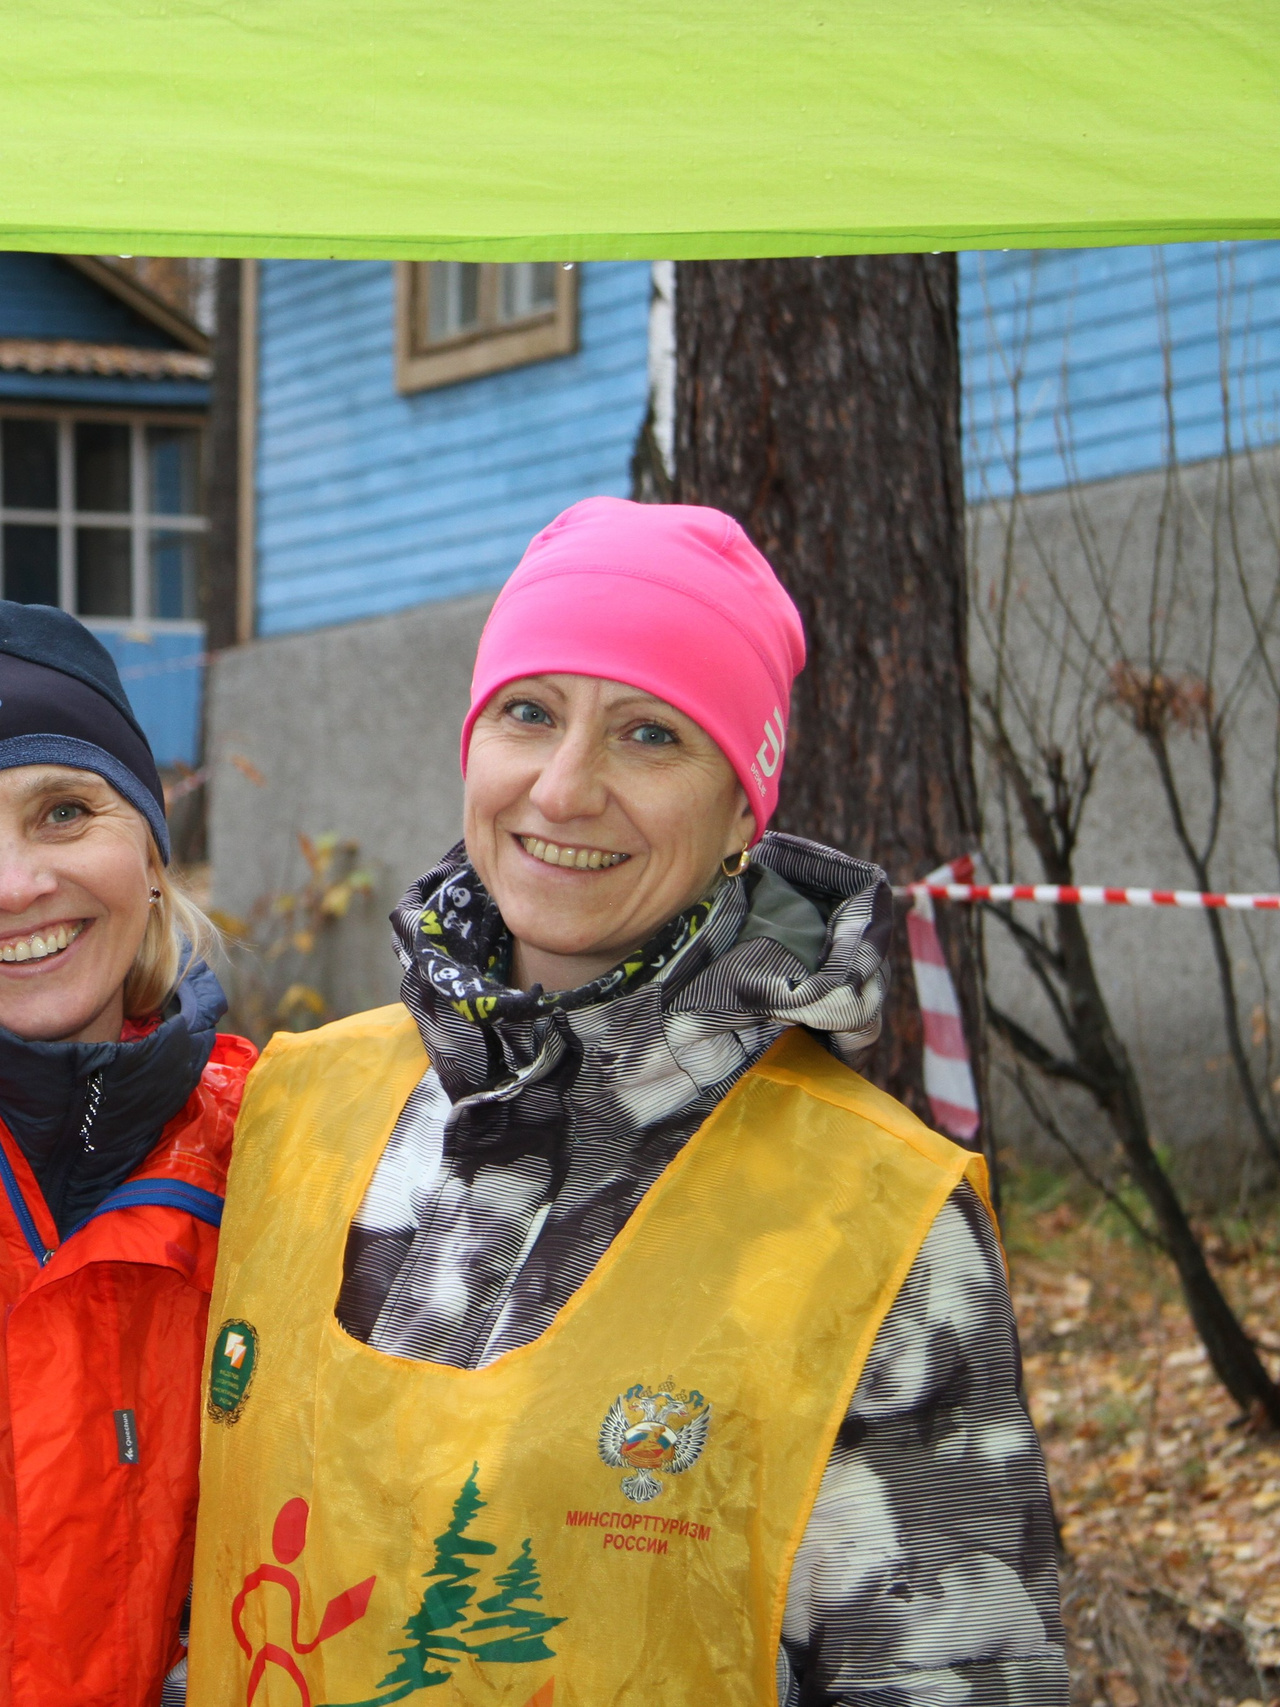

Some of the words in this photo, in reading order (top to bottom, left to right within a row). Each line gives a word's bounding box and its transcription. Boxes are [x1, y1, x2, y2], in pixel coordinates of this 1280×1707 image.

[122, 1413, 133, 1447] Quechua
[566, 1510, 711, 1541] МИНСПОРТТУРИЗМ
[603, 1533, 668, 1555] РОССИИ
